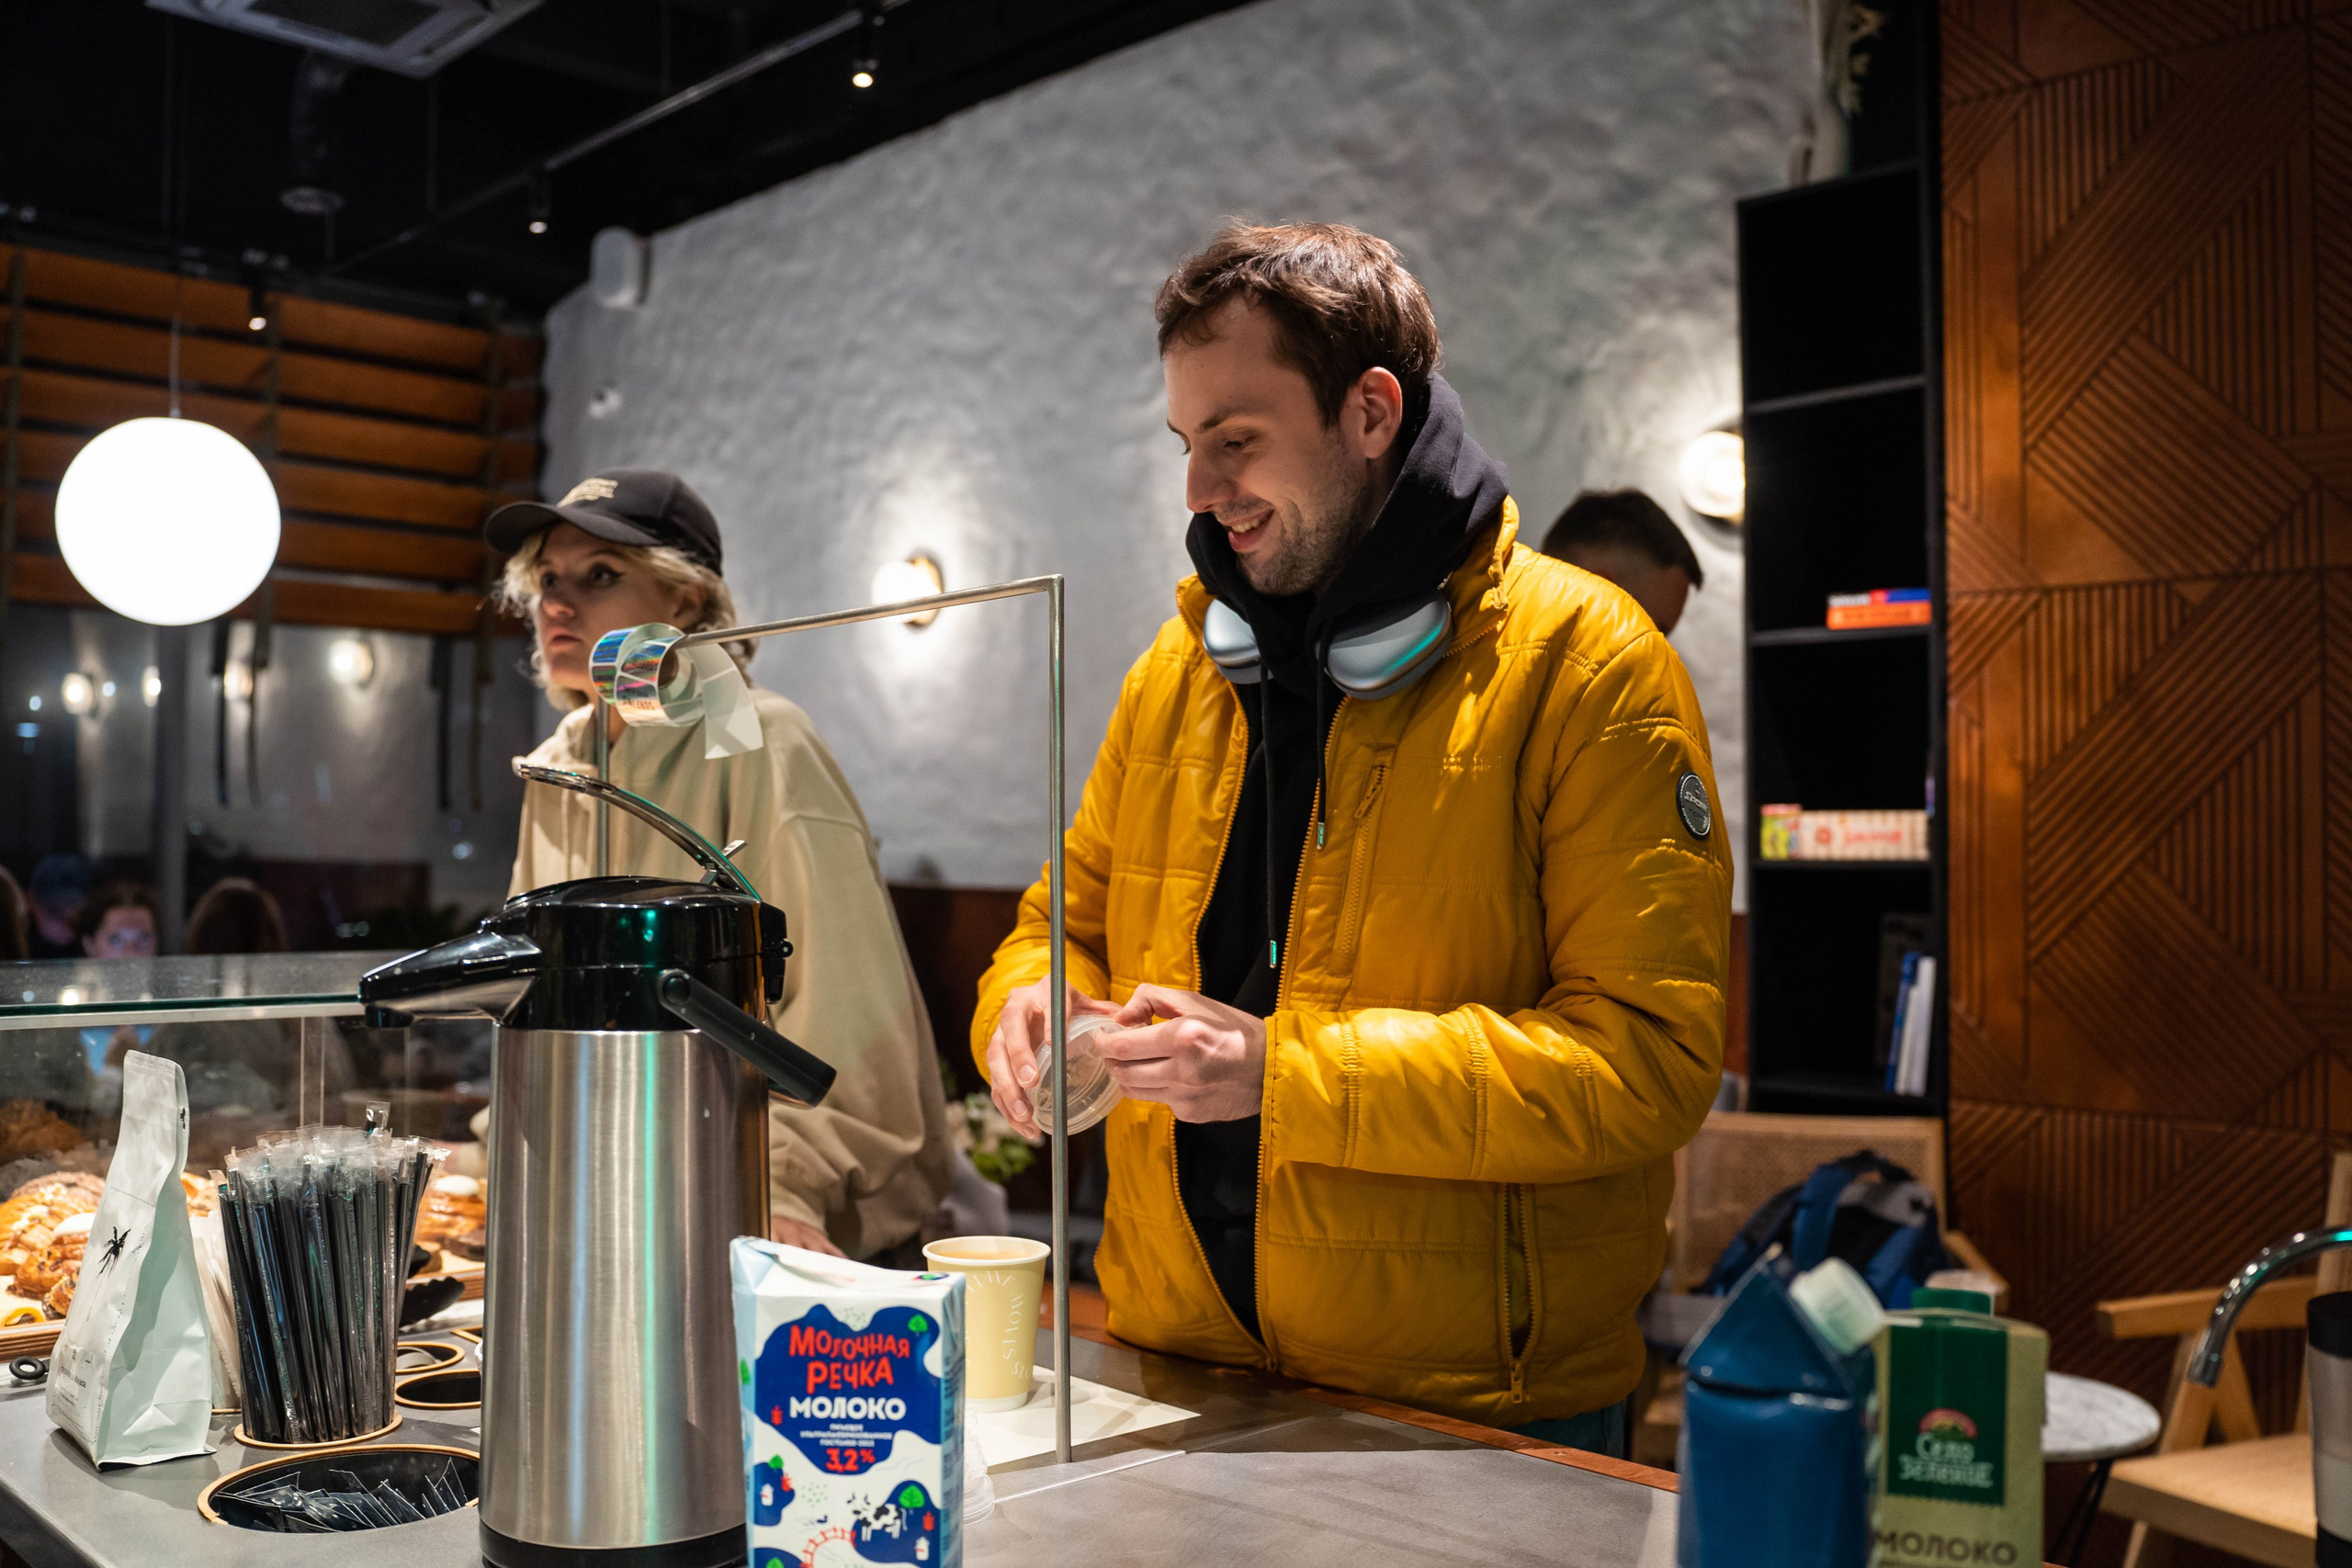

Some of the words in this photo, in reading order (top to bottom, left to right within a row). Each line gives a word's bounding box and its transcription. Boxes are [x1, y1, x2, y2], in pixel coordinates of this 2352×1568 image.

[806, 1356, 894, 1394] РЕЧКА
[789, 1395, 907, 1421] МОЛОКО
[1873, 1529, 2018, 1566] МОЛОКО
